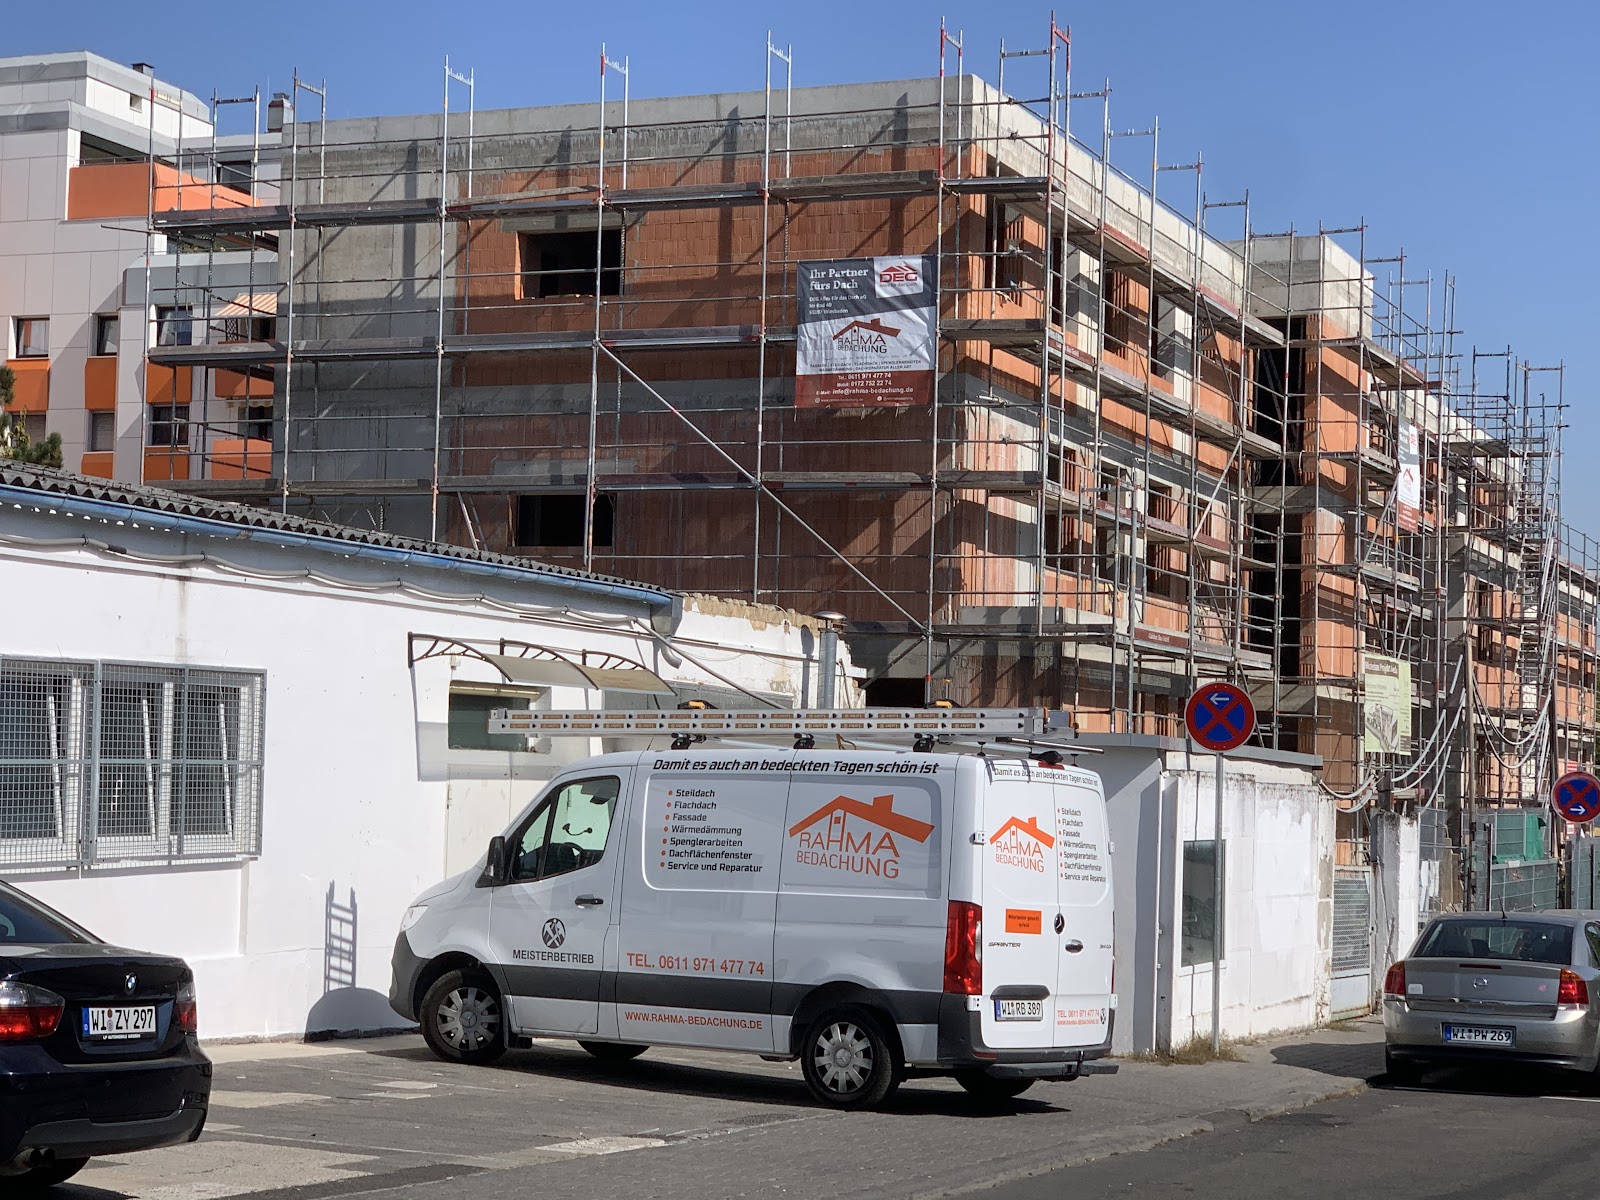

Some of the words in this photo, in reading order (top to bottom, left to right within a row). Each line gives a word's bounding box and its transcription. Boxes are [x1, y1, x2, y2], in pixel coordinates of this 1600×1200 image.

[810, 269, 826, 279] Ihr
[828, 268, 868, 278] Partner
[880, 272, 918, 282] DEG
[810, 281, 830, 290] fürs
[833, 279, 858, 289] Dach
[838, 334, 886, 345] RAHMA
[838, 345, 887, 353] BEDACHUNG
[652, 759, 690, 770] Damit
[692, 761, 706, 771] es
[712, 760, 740, 771] auch
[742, 762, 758, 771] an
[760, 759, 829, 772] bedeckten
[833, 761, 874, 774] Tagen
[875, 760, 916, 774] schön
[919, 762, 940, 774] ist
[994, 768, 1012, 776] Damit
[676, 788, 715, 798] Steildach
[674, 801, 717, 810] Flachdach
[672, 813, 707, 822] Fassade
[1061, 808, 1081, 816] Steildach
[1062, 819, 1083, 827] Flachdach
[671, 825, 742, 837] Wärmedämmung
[670, 837, 743, 849] Spenglerarbeiten
[800, 832, 900, 858] RAHMA
[668, 850, 753, 860] Dachflächenfenster
[996, 841, 1043, 858] RAHMA
[668, 861, 699, 871] Service
[701, 863, 717, 872] und
[719, 863, 763, 874] Reparatur
[796, 851, 900, 879] BEDACHUNG
[996, 854, 1044, 873] BEDACHUNG
[512, 950, 594, 964] MEISTERBETRIEB
[626, 953, 655, 968] TEL.
[659, 955, 688, 971] 0611
[693, 957, 715, 972] 971
[720, 960, 743, 974] 477
[748, 961, 765, 975] 74
[1001, 1002, 1011, 1015] WI
[1016, 1002, 1026, 1015] RB
[1027, 1002, 1041, 1015] 389
[91, 1010, 107, 1031] WI
[115, 1009, 130, 1030] ZY
[133, 1009, 153, 1029] 297
[625, 1011, 763, 1030] WWW.RAHMA-BEDACHUNG.DE
[1452, 1028, 1465, 1039] WI
[1474, 1029, 1488, 1040] PW
[1490, 1030, 1511, 1042] 269
